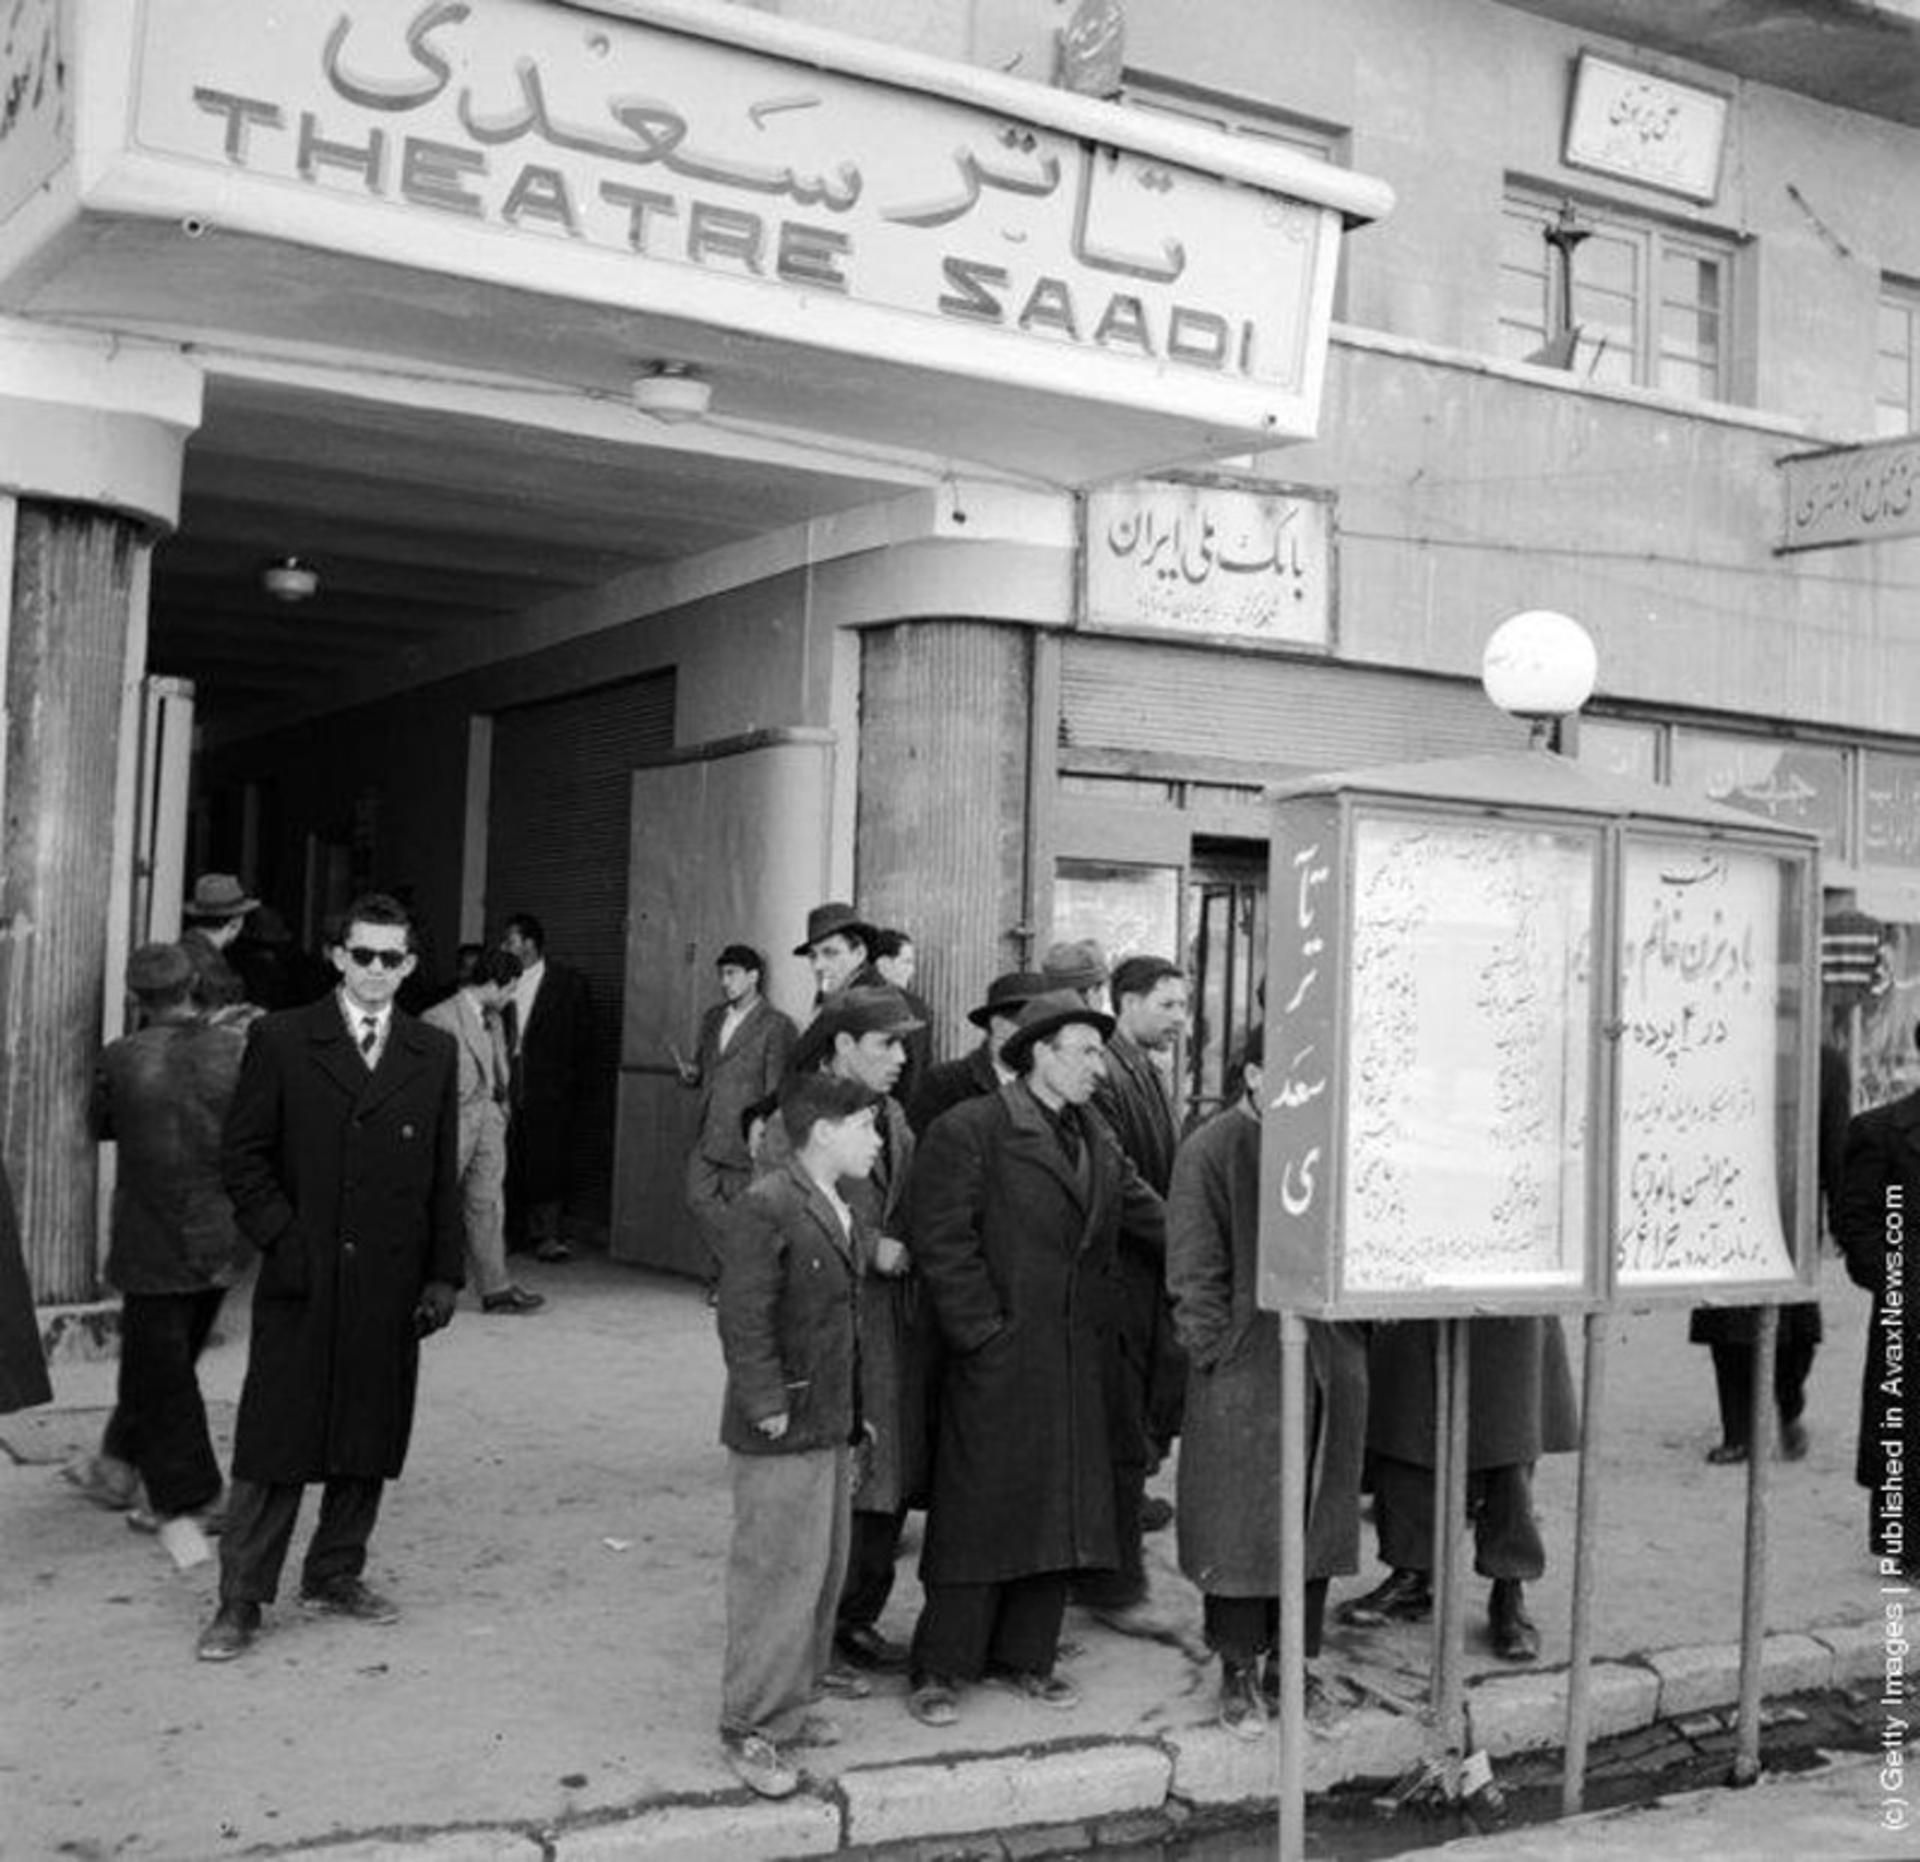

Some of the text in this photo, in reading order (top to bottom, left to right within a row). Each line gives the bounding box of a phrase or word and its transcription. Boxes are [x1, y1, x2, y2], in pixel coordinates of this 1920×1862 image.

[192, 85, 1258, 377] THEATRE SAADI
[1107, 506, 1306, 600] بانک ملی ایران
[1632, 1017, 1680, 1070] پرده
[1697, 1017, 1728, 1048] در
